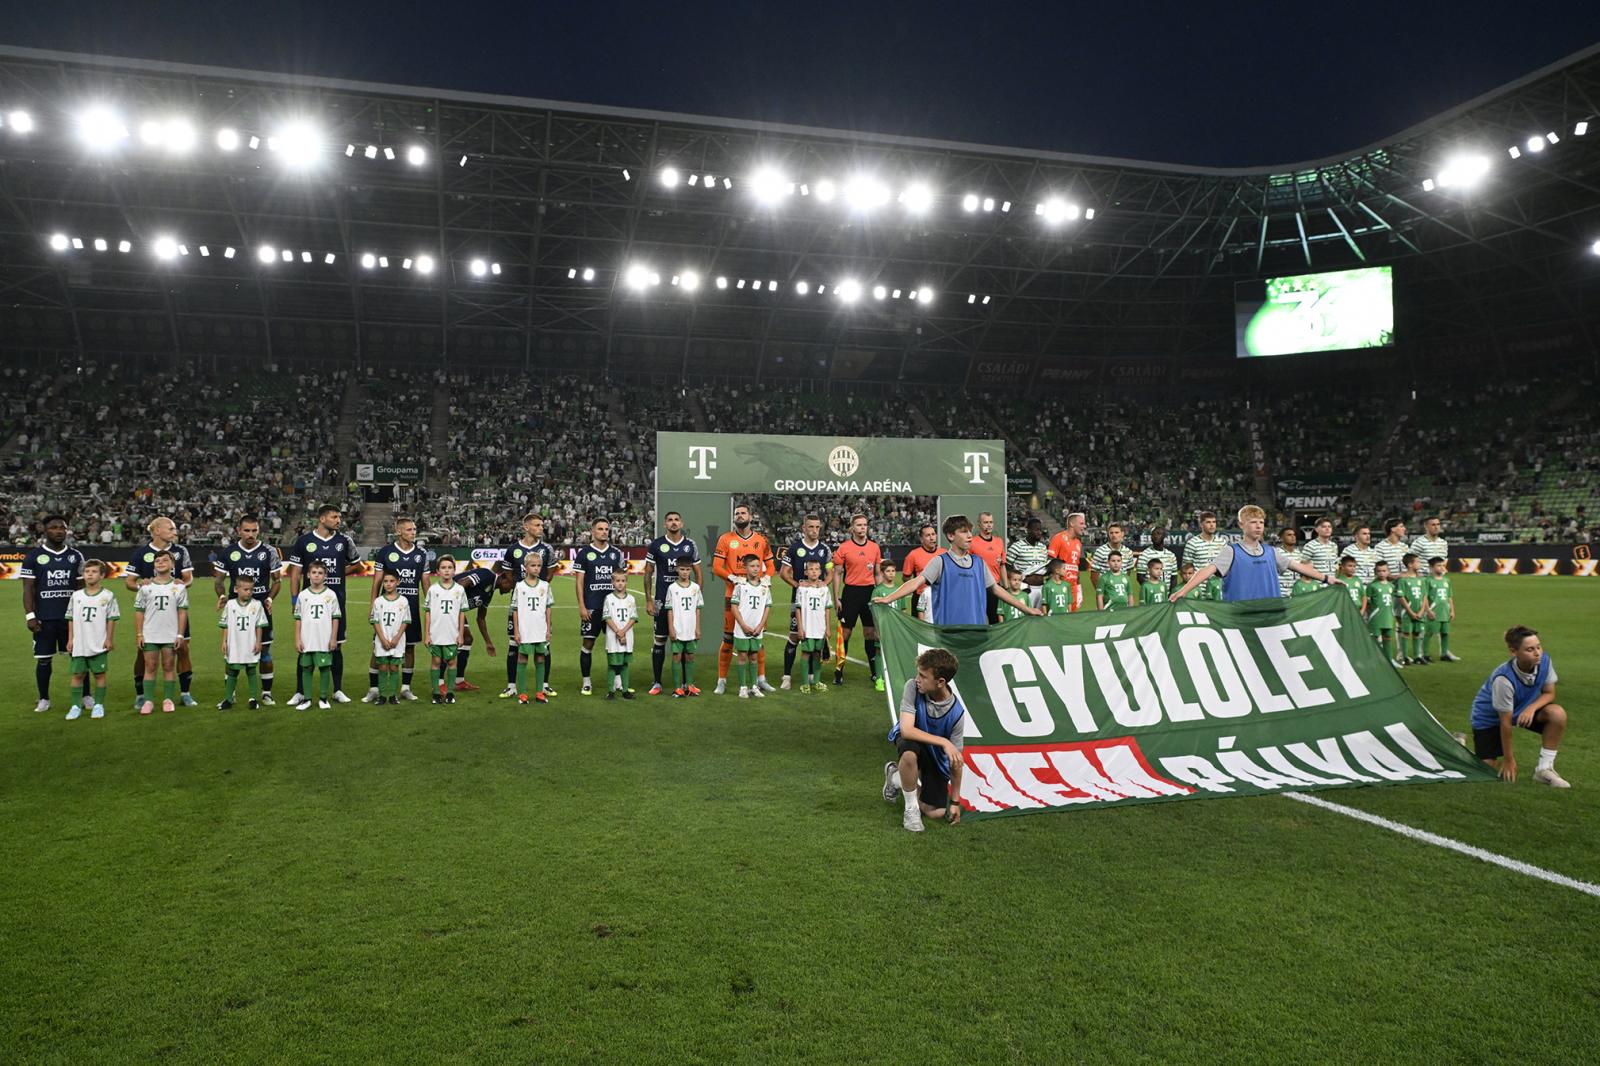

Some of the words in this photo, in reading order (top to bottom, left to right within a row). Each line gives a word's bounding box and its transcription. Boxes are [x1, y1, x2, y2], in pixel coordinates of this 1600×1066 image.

[376, 465, 419, 475] Groupama
[774, 479, 859, 493] GROUPAMA
[862, 477, 913, 494] ARÉNA
[1284, 496, 1338, 508] PENNY
[47, 579, 70, 587] BANK
[979, 612, 1370, 738] GYŰLÖLET
